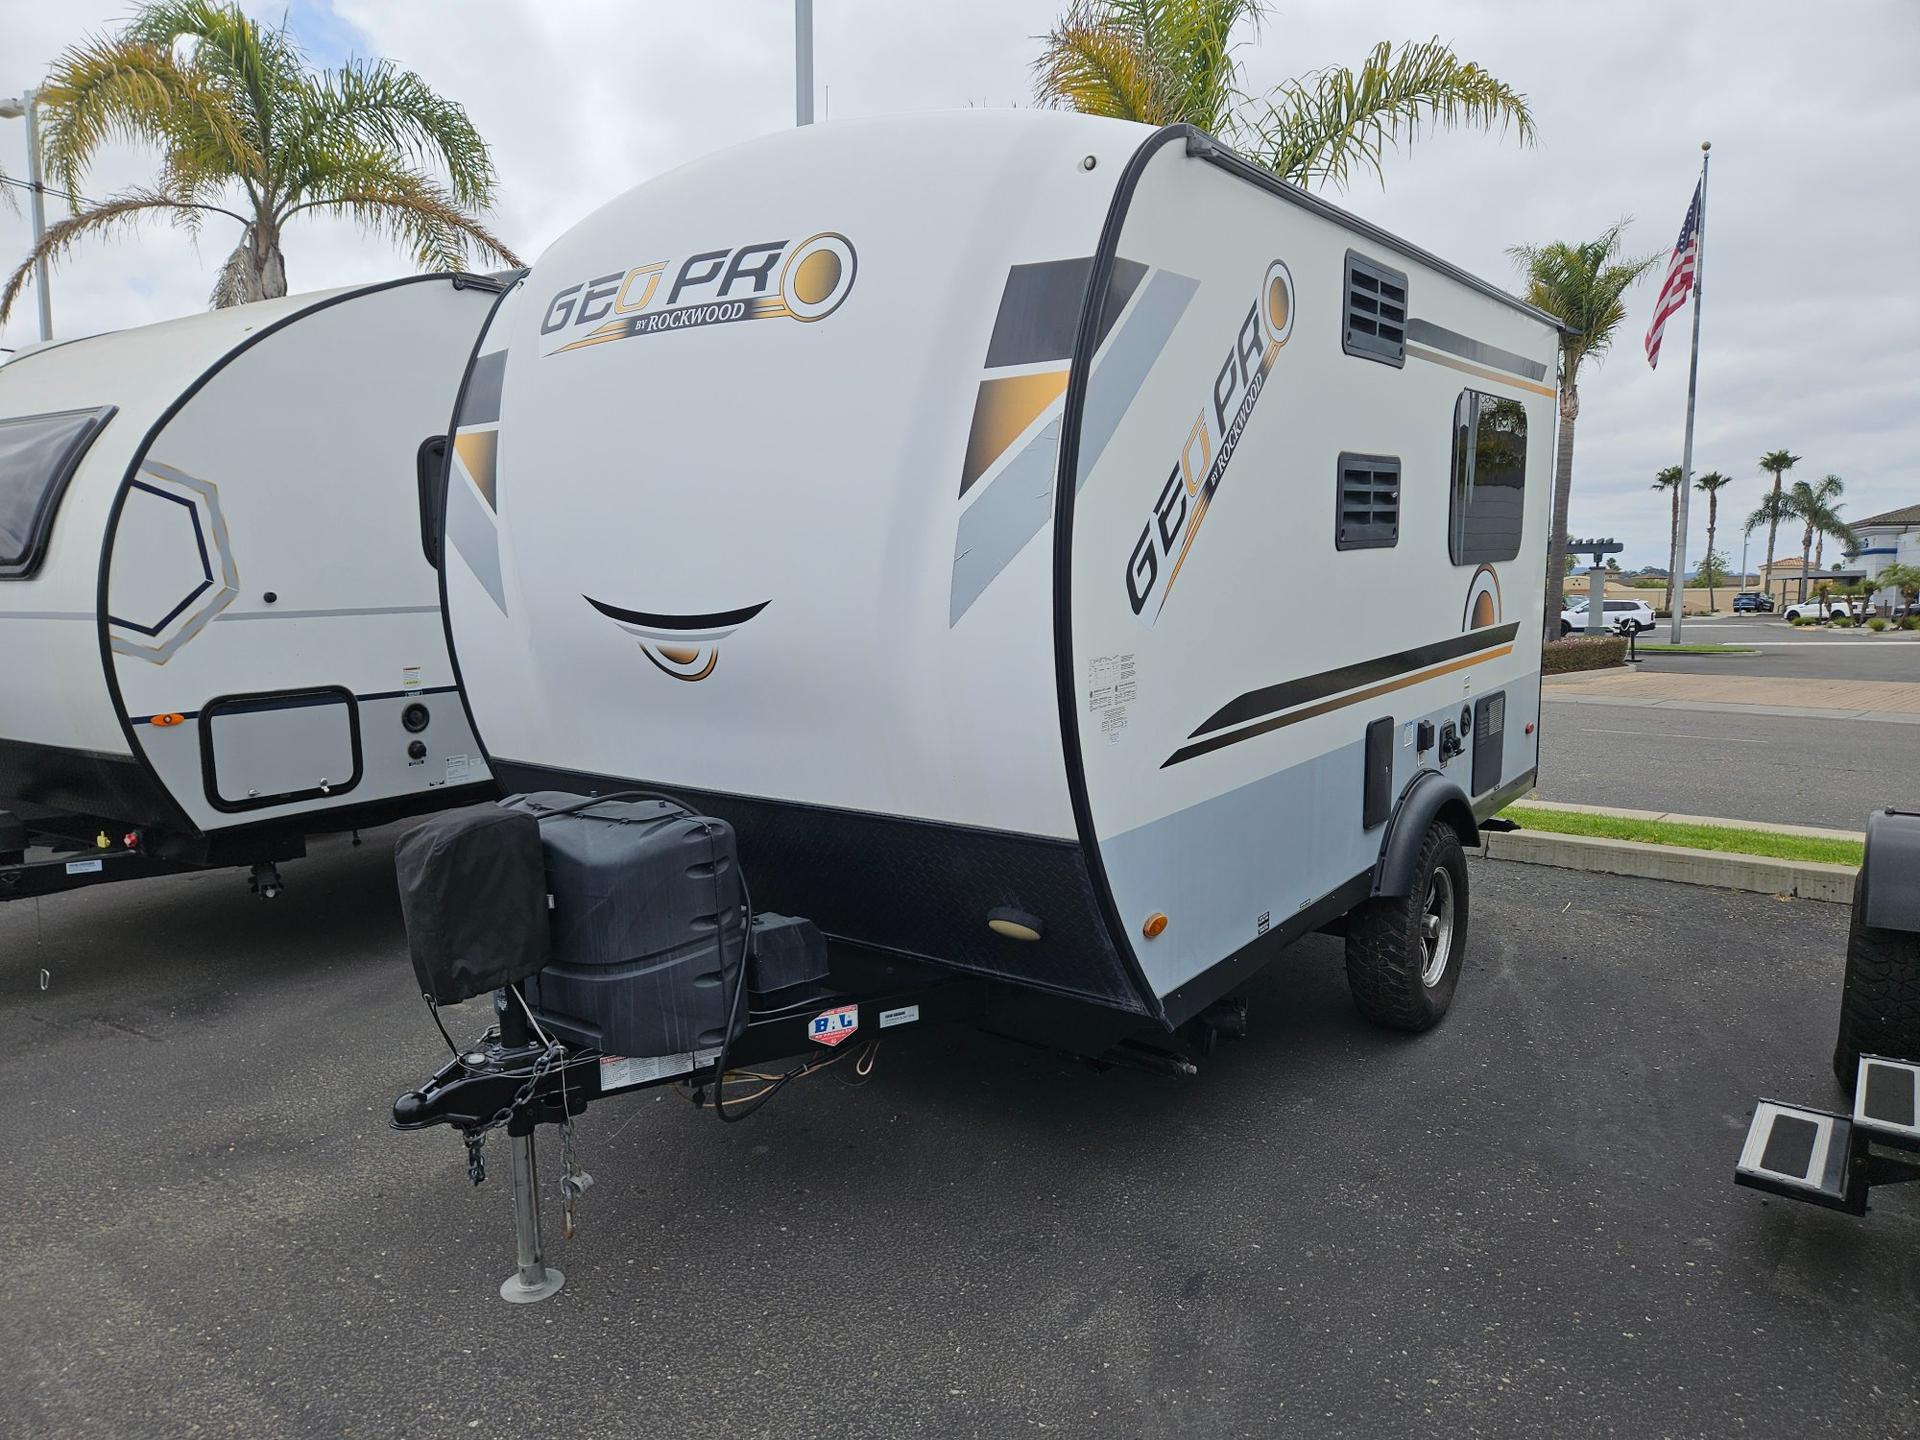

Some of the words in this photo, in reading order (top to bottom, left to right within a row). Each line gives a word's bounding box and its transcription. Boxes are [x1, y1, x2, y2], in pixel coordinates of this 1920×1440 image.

[540, 260, 670, 336] GEO
[634, 320, 647, 331] BY
[647, 302, 745, 332] ROCKWOOD
[1210, 470, 1220, 486] BY
[1217, 373, 1264, 477] ROCKWOOD
